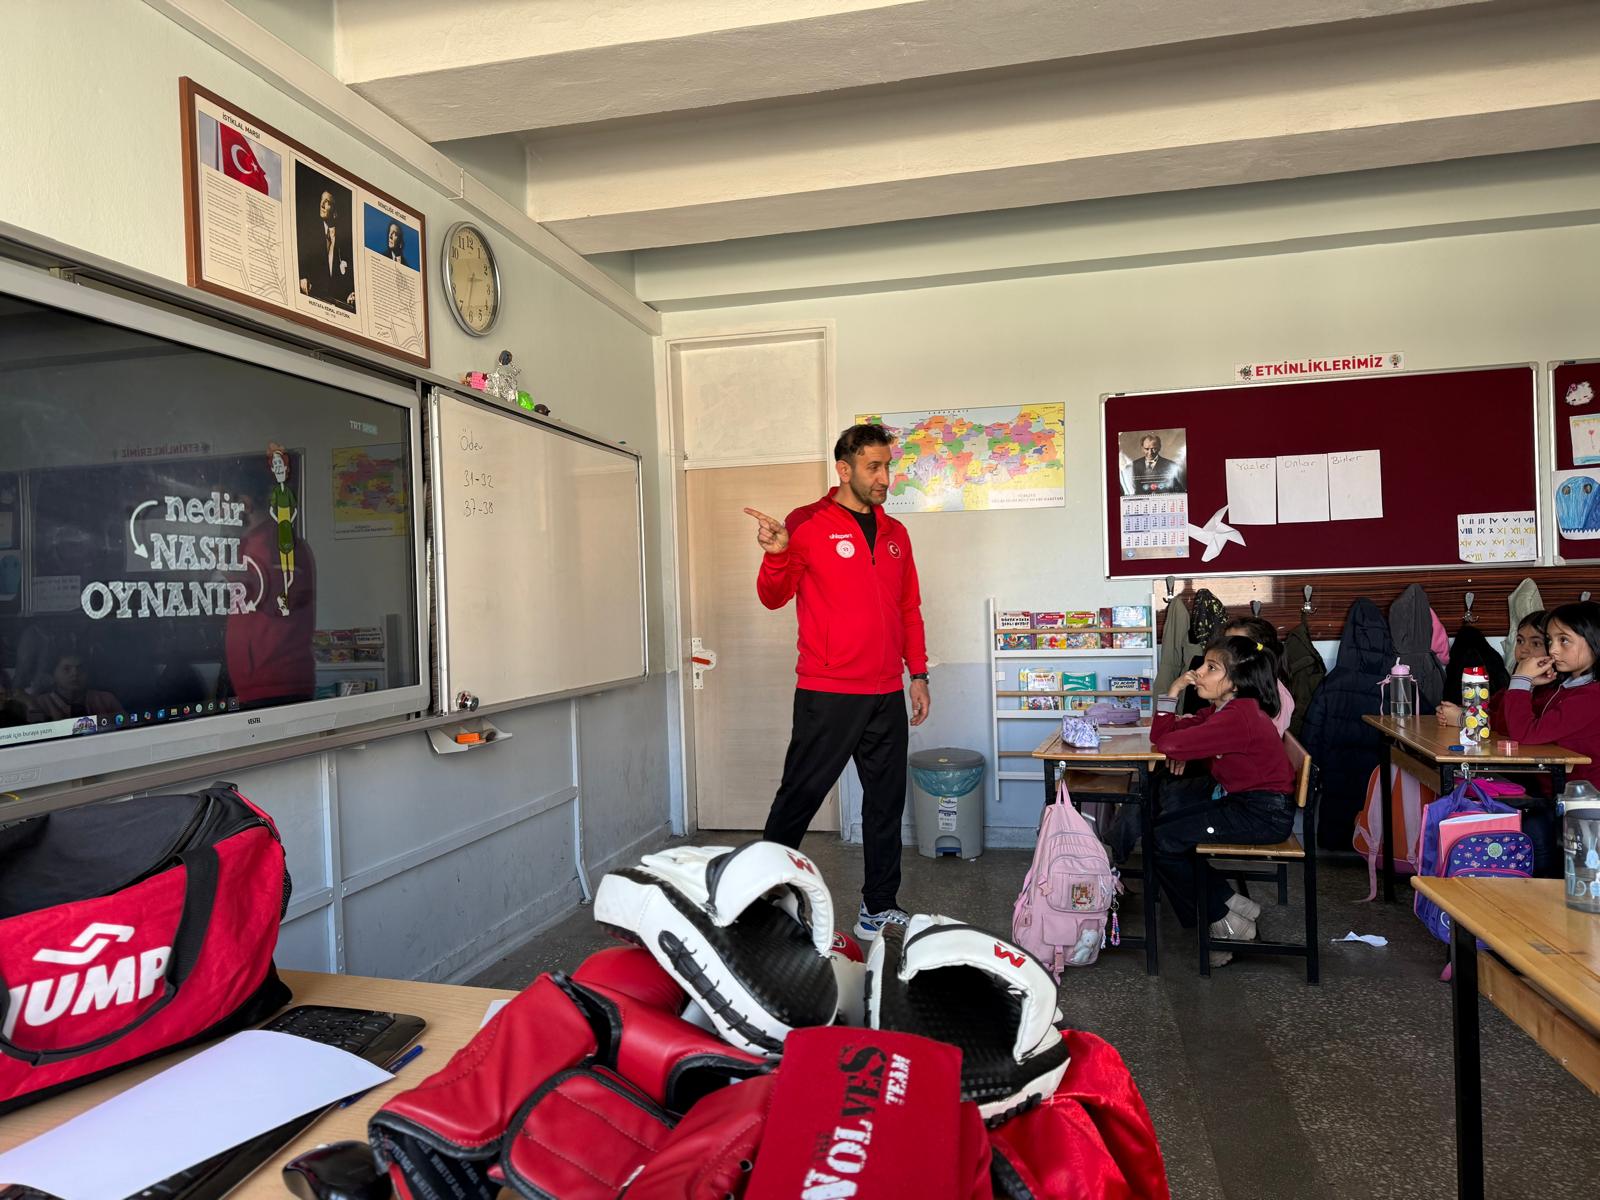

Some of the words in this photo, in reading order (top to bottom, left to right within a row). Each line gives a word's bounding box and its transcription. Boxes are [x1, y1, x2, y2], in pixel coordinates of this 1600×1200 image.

[1255, 354, 1383, 377] ETKİNLİKLERİMİZ
[165, 491, 245, 526] nedir
[150, 532, 248, 572] NASIL
[80, 580, 253, 620] OYNANIR
[885, 1053, 912, 1106] TEAM
